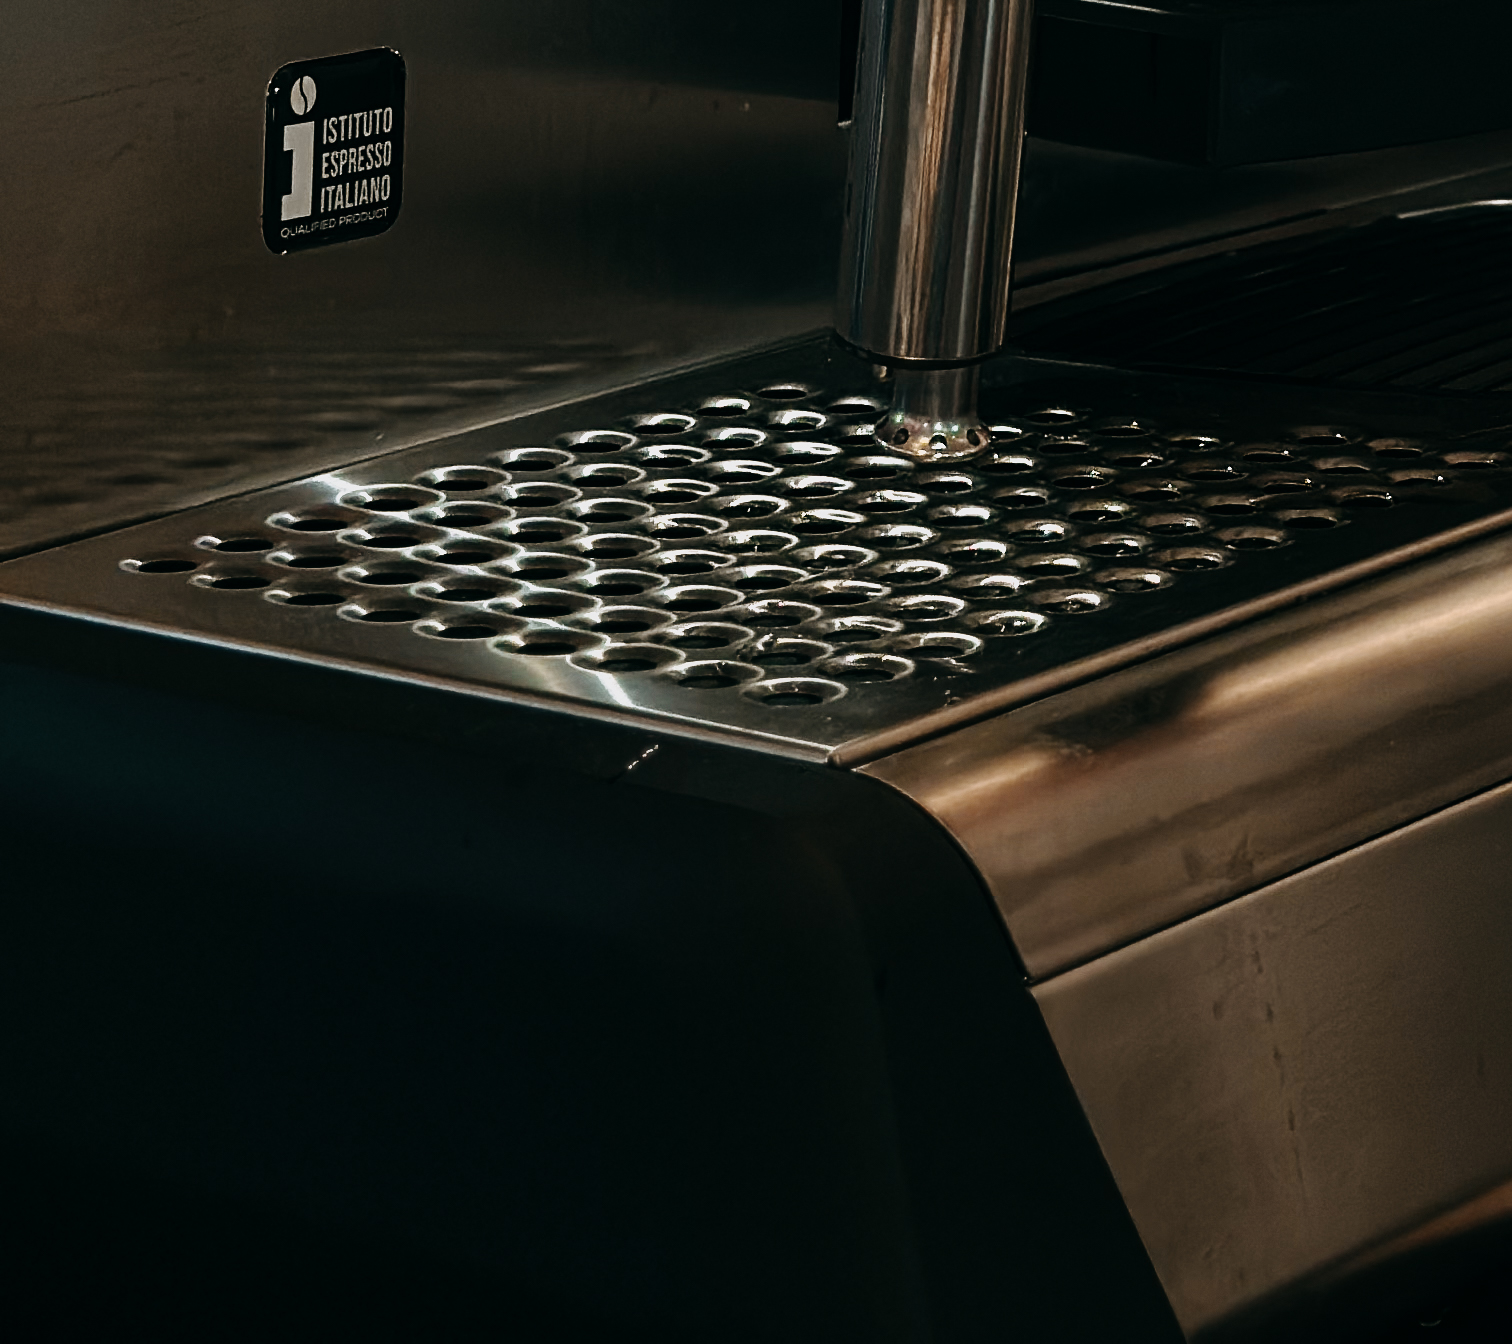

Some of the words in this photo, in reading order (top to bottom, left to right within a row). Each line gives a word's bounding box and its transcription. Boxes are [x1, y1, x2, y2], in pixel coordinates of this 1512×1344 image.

[322, 107, 393, 145] ISTITUTO
[321, 140, 392, 179] ESPRESSO
[320, 174, 391, 213] ITALIANO
[280, 218, 337, 239] QUALIFIED
[338, 206, 389, 227] PRODUCT
